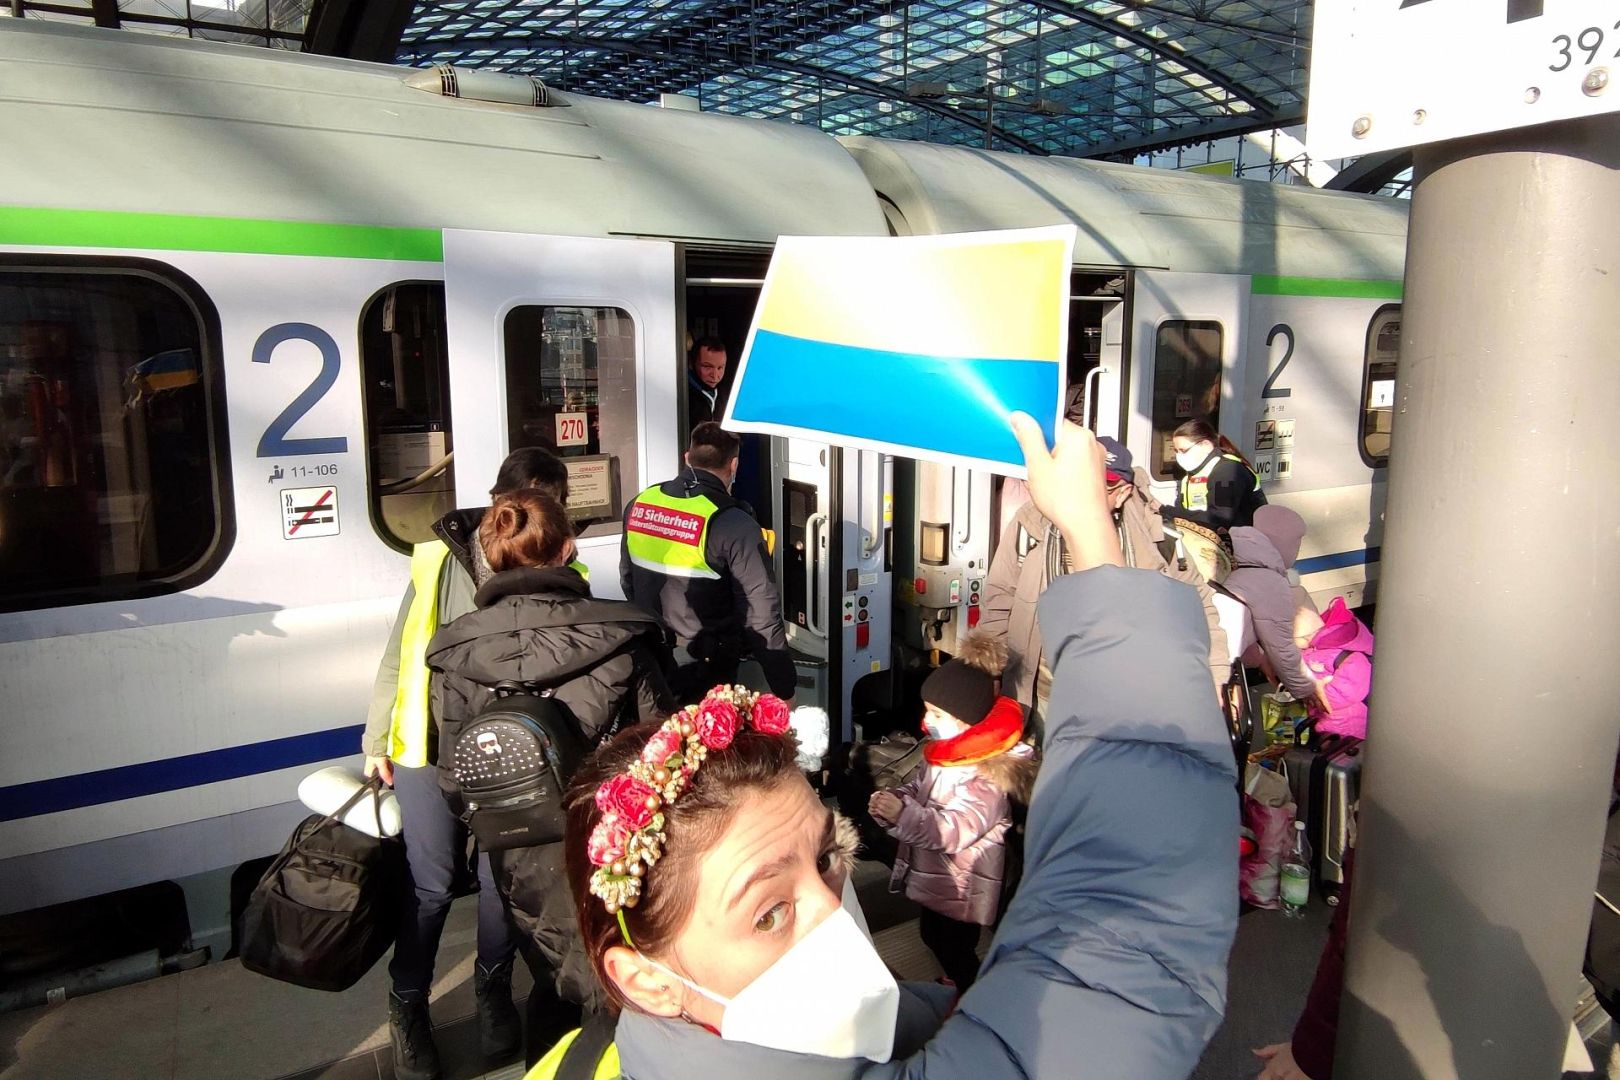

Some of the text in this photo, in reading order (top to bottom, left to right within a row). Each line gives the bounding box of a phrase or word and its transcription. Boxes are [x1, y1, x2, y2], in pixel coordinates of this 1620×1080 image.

[1548, 19, 1620, 72] 39
[1262, 323, 1294, 399] 2
[252, 322, 348, 458] 2
[561, 419, 584, 440] 270
[291, 463, 338, 478] 11-106
[1257, 461, 1271, 474] WC
[631, 506, 699, 531] DB Sicherheit
